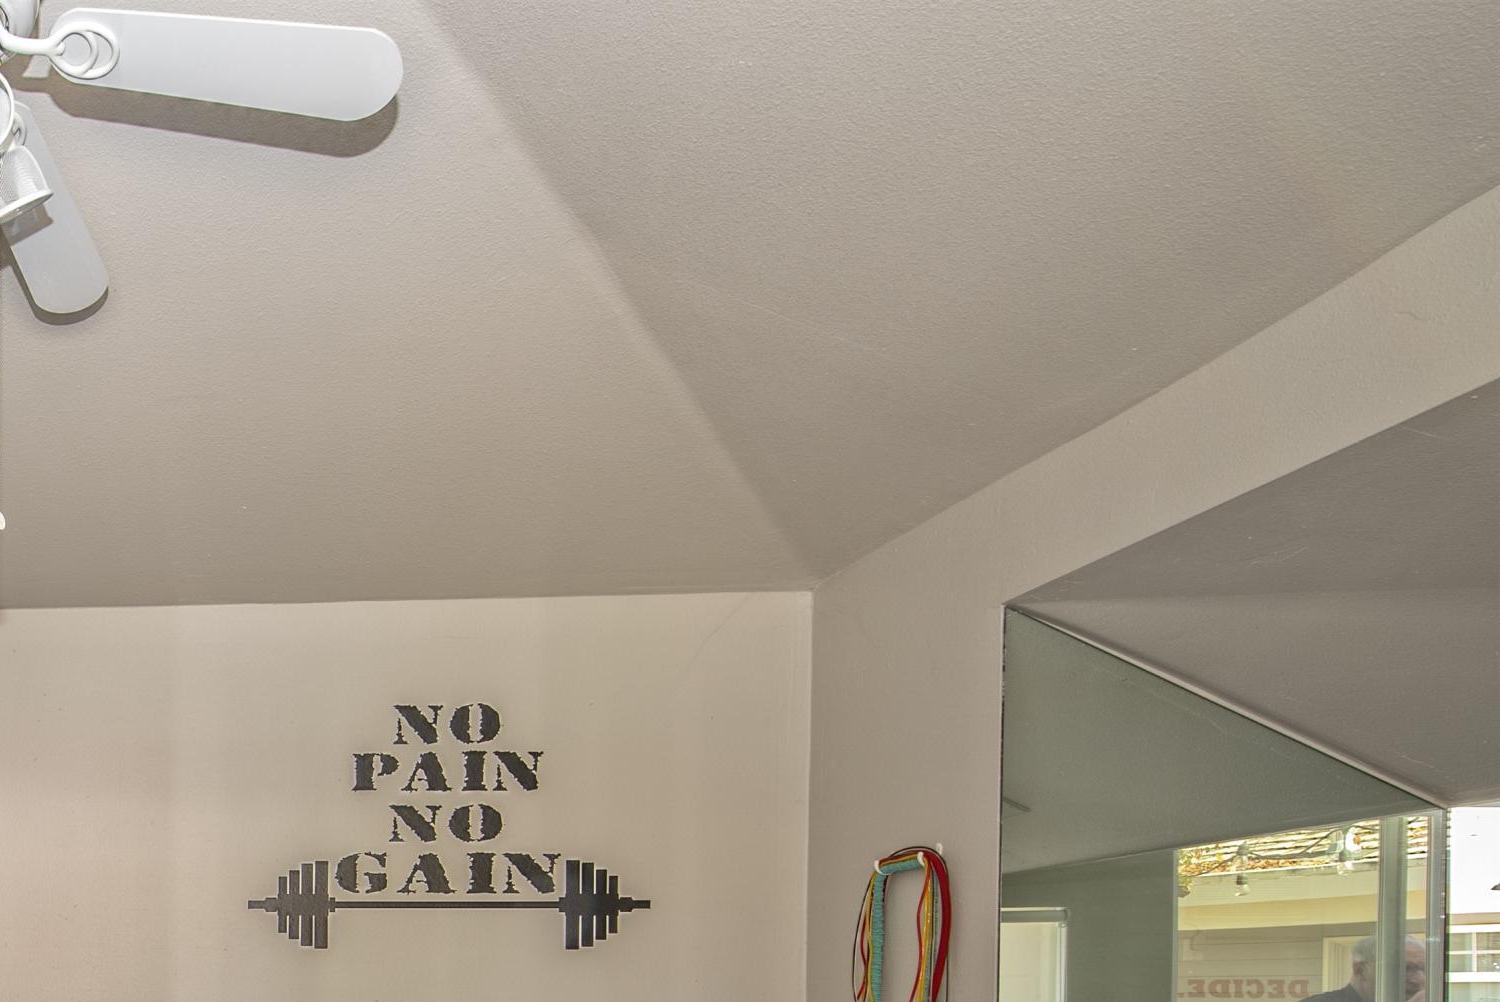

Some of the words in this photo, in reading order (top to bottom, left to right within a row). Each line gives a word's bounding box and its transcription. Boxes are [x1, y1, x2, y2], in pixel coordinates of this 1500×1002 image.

[393, 702, 501, 745] NO
[351, 750, 544, 792] PAIN
[389, 803, 503, 842] NO
[334, 851, 561, 894] GAIN
